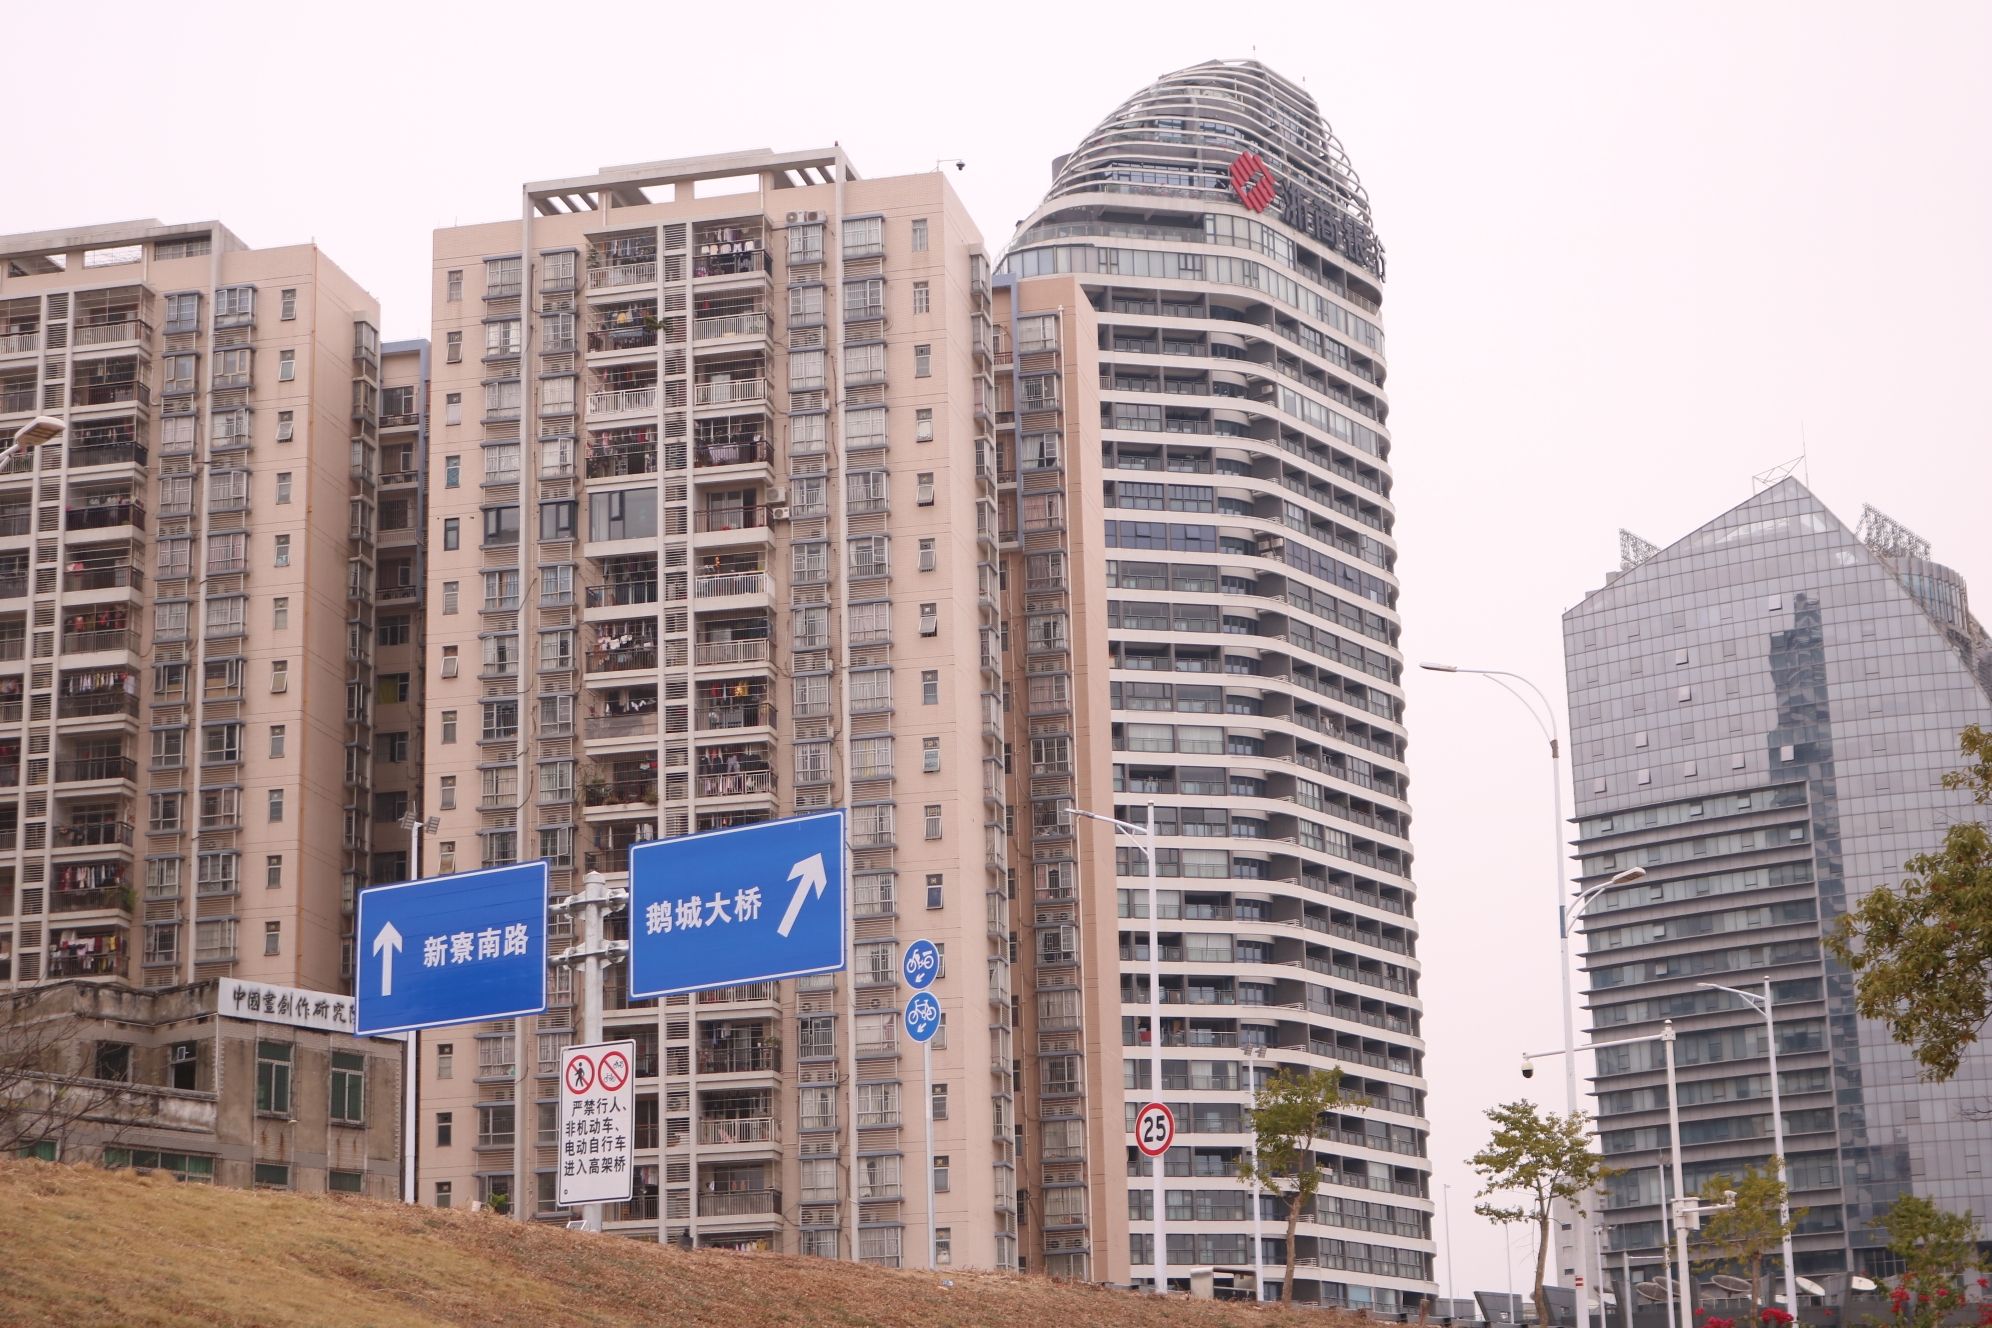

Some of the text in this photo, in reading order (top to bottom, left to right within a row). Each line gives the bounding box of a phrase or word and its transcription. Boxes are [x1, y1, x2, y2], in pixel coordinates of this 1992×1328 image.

[646, 886, 762, 935] 鹅城大桥
[423, 923, 529, 968] 新寮南路
[572, 1096, 627, 1117] 严禁行人、
[565, 1117, 619, 1137] 非机动车、
[1144, 1115, 1166, 1142] 25
[565, 1135, 626, 1156] 电动自行车
[564, 1155, 626, 1176] 进入高架桥
